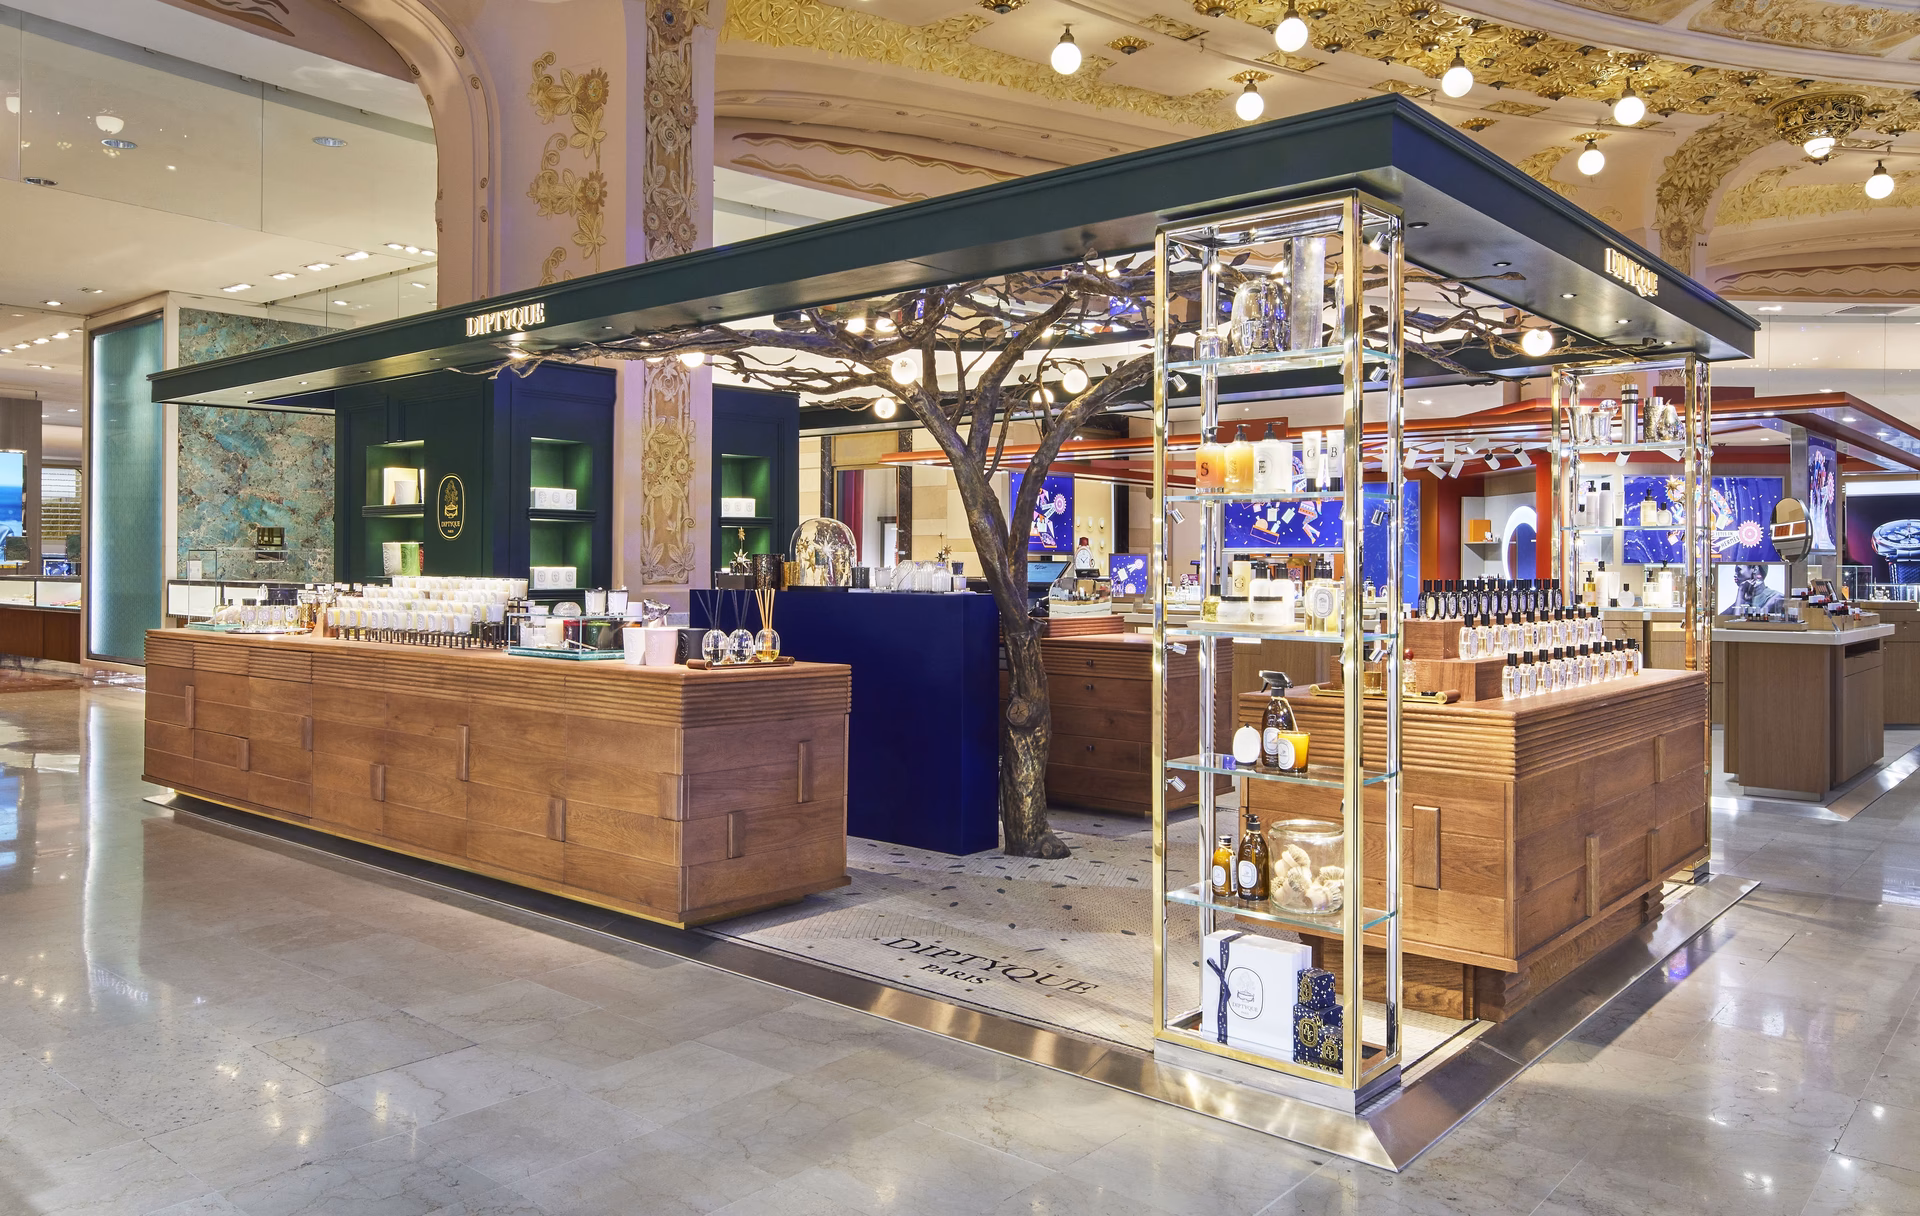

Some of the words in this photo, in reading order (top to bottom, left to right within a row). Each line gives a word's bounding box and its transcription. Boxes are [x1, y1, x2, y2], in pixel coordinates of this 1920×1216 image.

[465, 302, 545, 337] DIPTYQUE
[1200, 462, 1209, 476] S
[881, 937, 1099, 995] DIPTYQUE
[919, 964, 990, 984] PARIS
